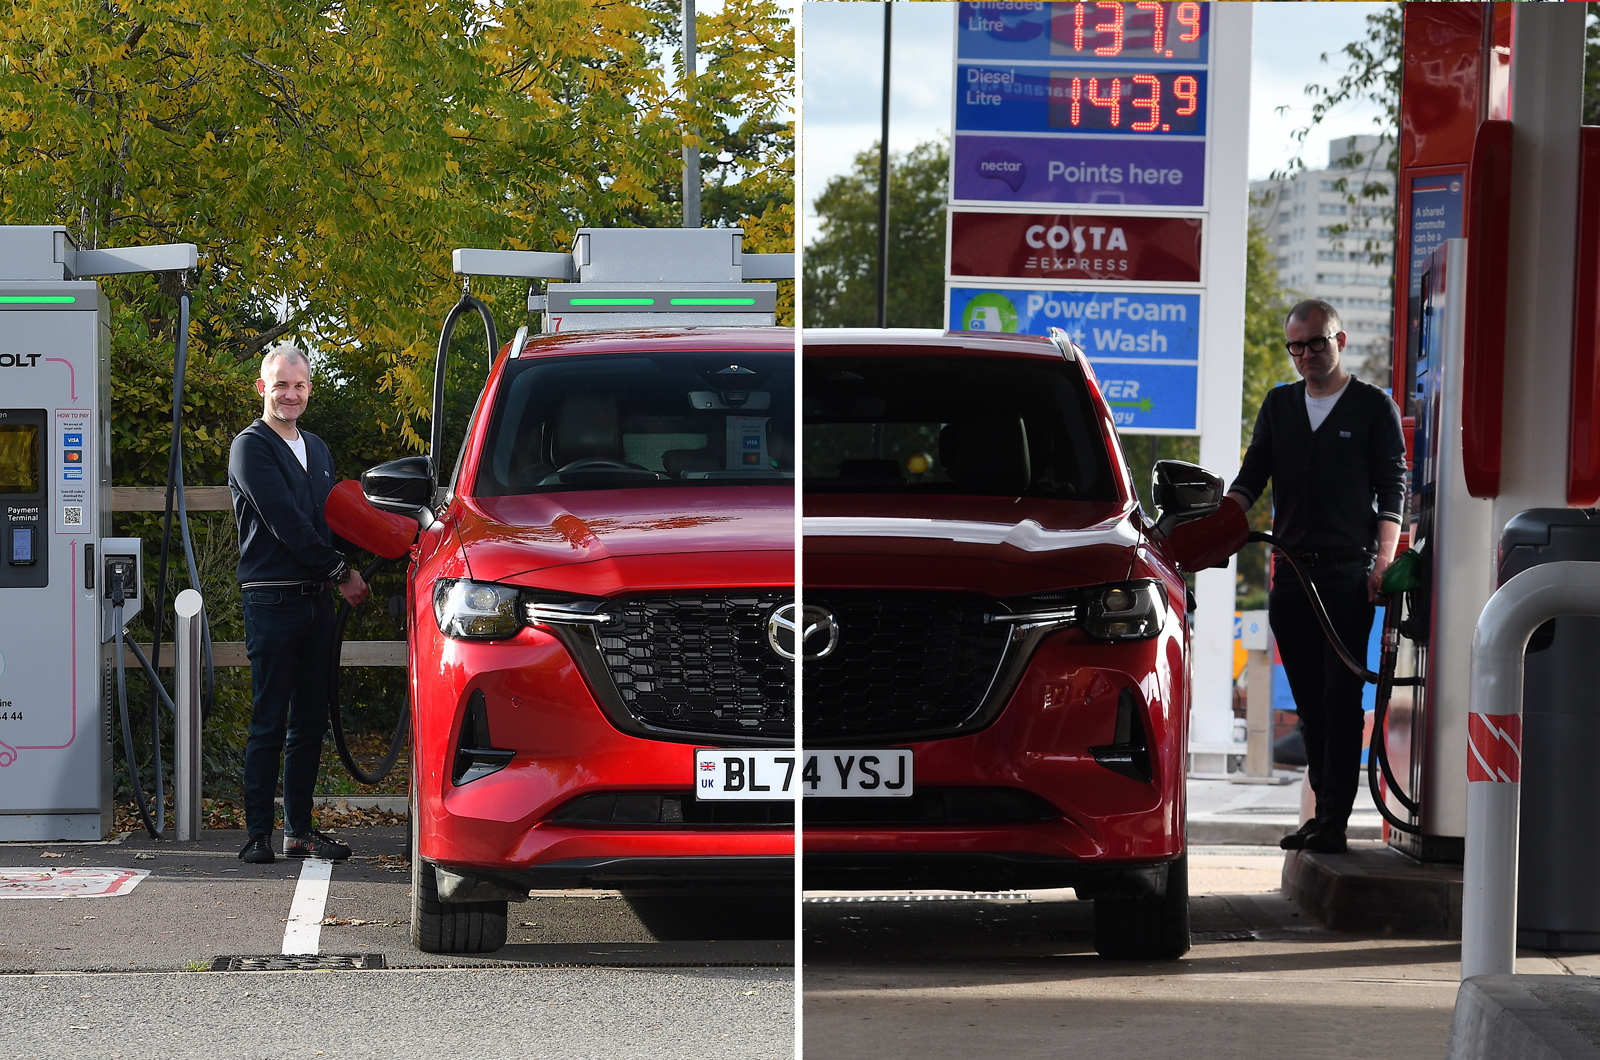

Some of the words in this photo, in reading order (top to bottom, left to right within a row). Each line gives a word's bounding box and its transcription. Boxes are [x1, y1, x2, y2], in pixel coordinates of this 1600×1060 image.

[968, 16, 1004, 32] Litre
[966, 90, 1002, 106] Litre
[966, 69, 1015, 84] Diesel
[1071, 74, 1198, 131] 143.9
[981, 160, 1022, 172] nectar
[1048, 160, 1124, 184] Points
[1129, 163, 1184, 186] here
[1415, 207, 1421, 218] A
[1422, 204, 1444, 217] shared
[1415, 219, 1446, 230] commute
[1025, 224, 1128, 253] COSTA
[1414, 233, 1426, 243] can
[1427, 231, 1436, 242] be
[1437, 233, 1442, 241] a
[1414, 245, 1427, 255] less
[1040, 257, 1128, 271] EXPRESS
[1027, 295, 1187, 322] PowerFoam
[552, 317, 563, 332] 7
[1093, 328, 1168, 352] Wash
[8, 506, 38, 515] Payment
[10, 711, 23, 721] 44
[834, 755, 906, 790] YSJ
[701, 779, 714, 788] UK
